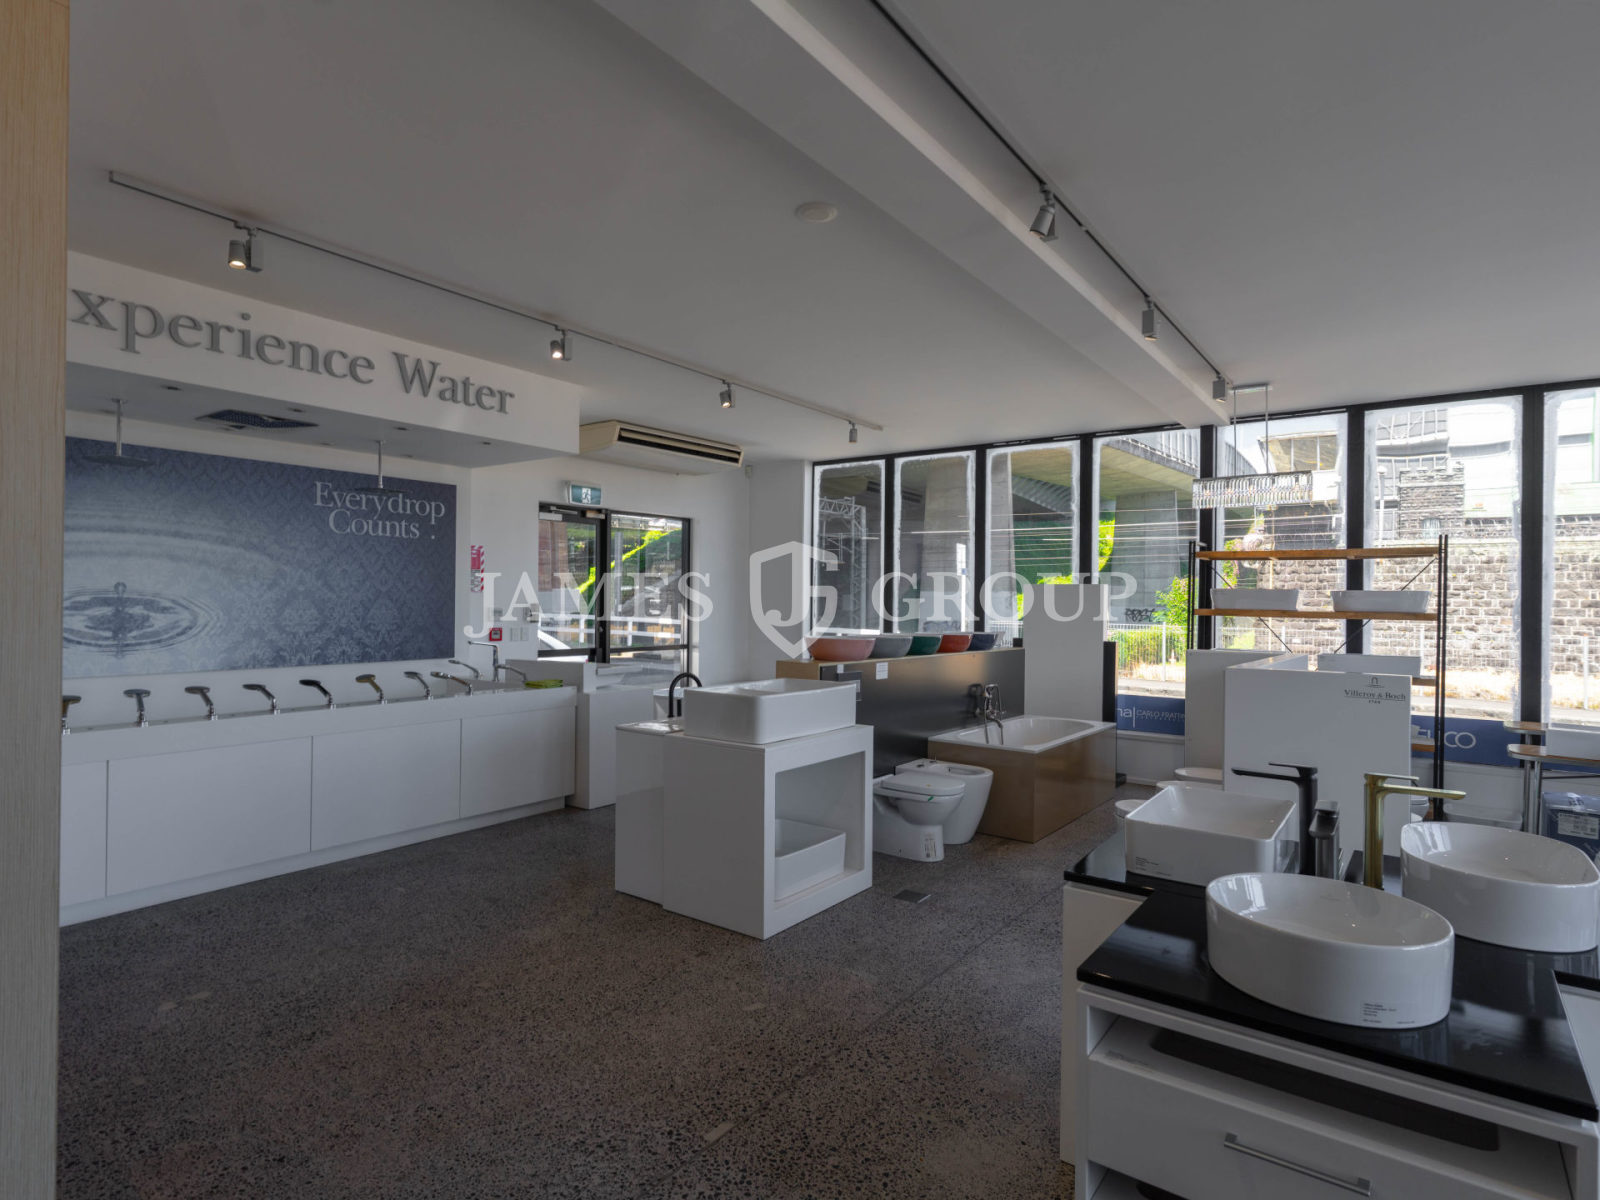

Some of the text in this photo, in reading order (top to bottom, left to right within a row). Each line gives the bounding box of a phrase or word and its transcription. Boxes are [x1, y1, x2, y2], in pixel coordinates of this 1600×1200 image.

[392, 350, 516, 415] Water
[314, 481, 446, 525] Everydrop
[328, 508, 421, 540] Counts
[1136, 709, 1160, 717] CARLO
